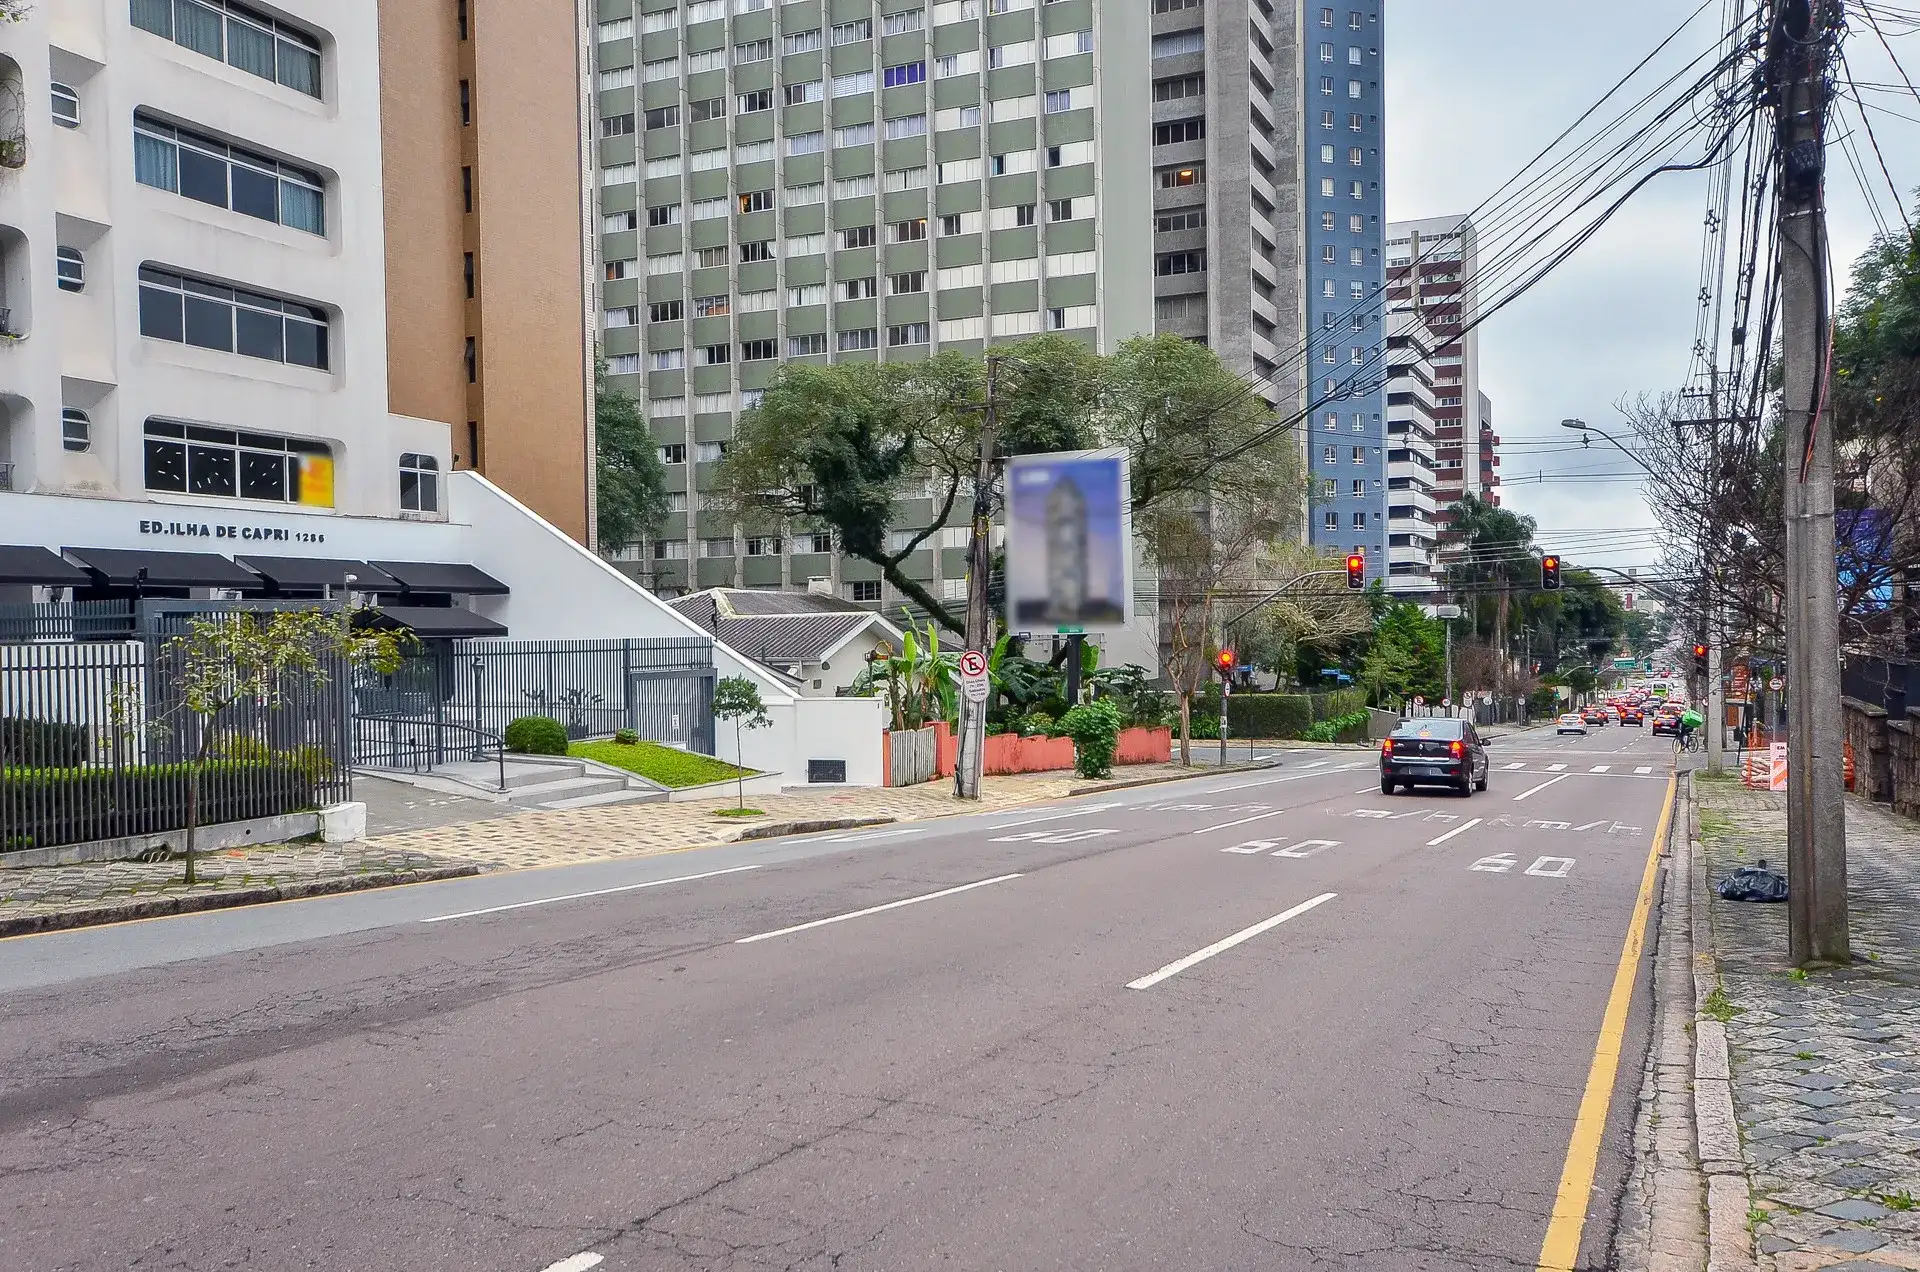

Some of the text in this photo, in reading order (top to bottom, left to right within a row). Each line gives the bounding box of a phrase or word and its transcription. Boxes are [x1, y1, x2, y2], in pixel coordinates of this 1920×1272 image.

[215, 525, 237, 539] DE
[241, 527, 289, 541] CAPRI
[1218, 836, 1345, 859] 60
[1466, 852, 1577, 878] 60
